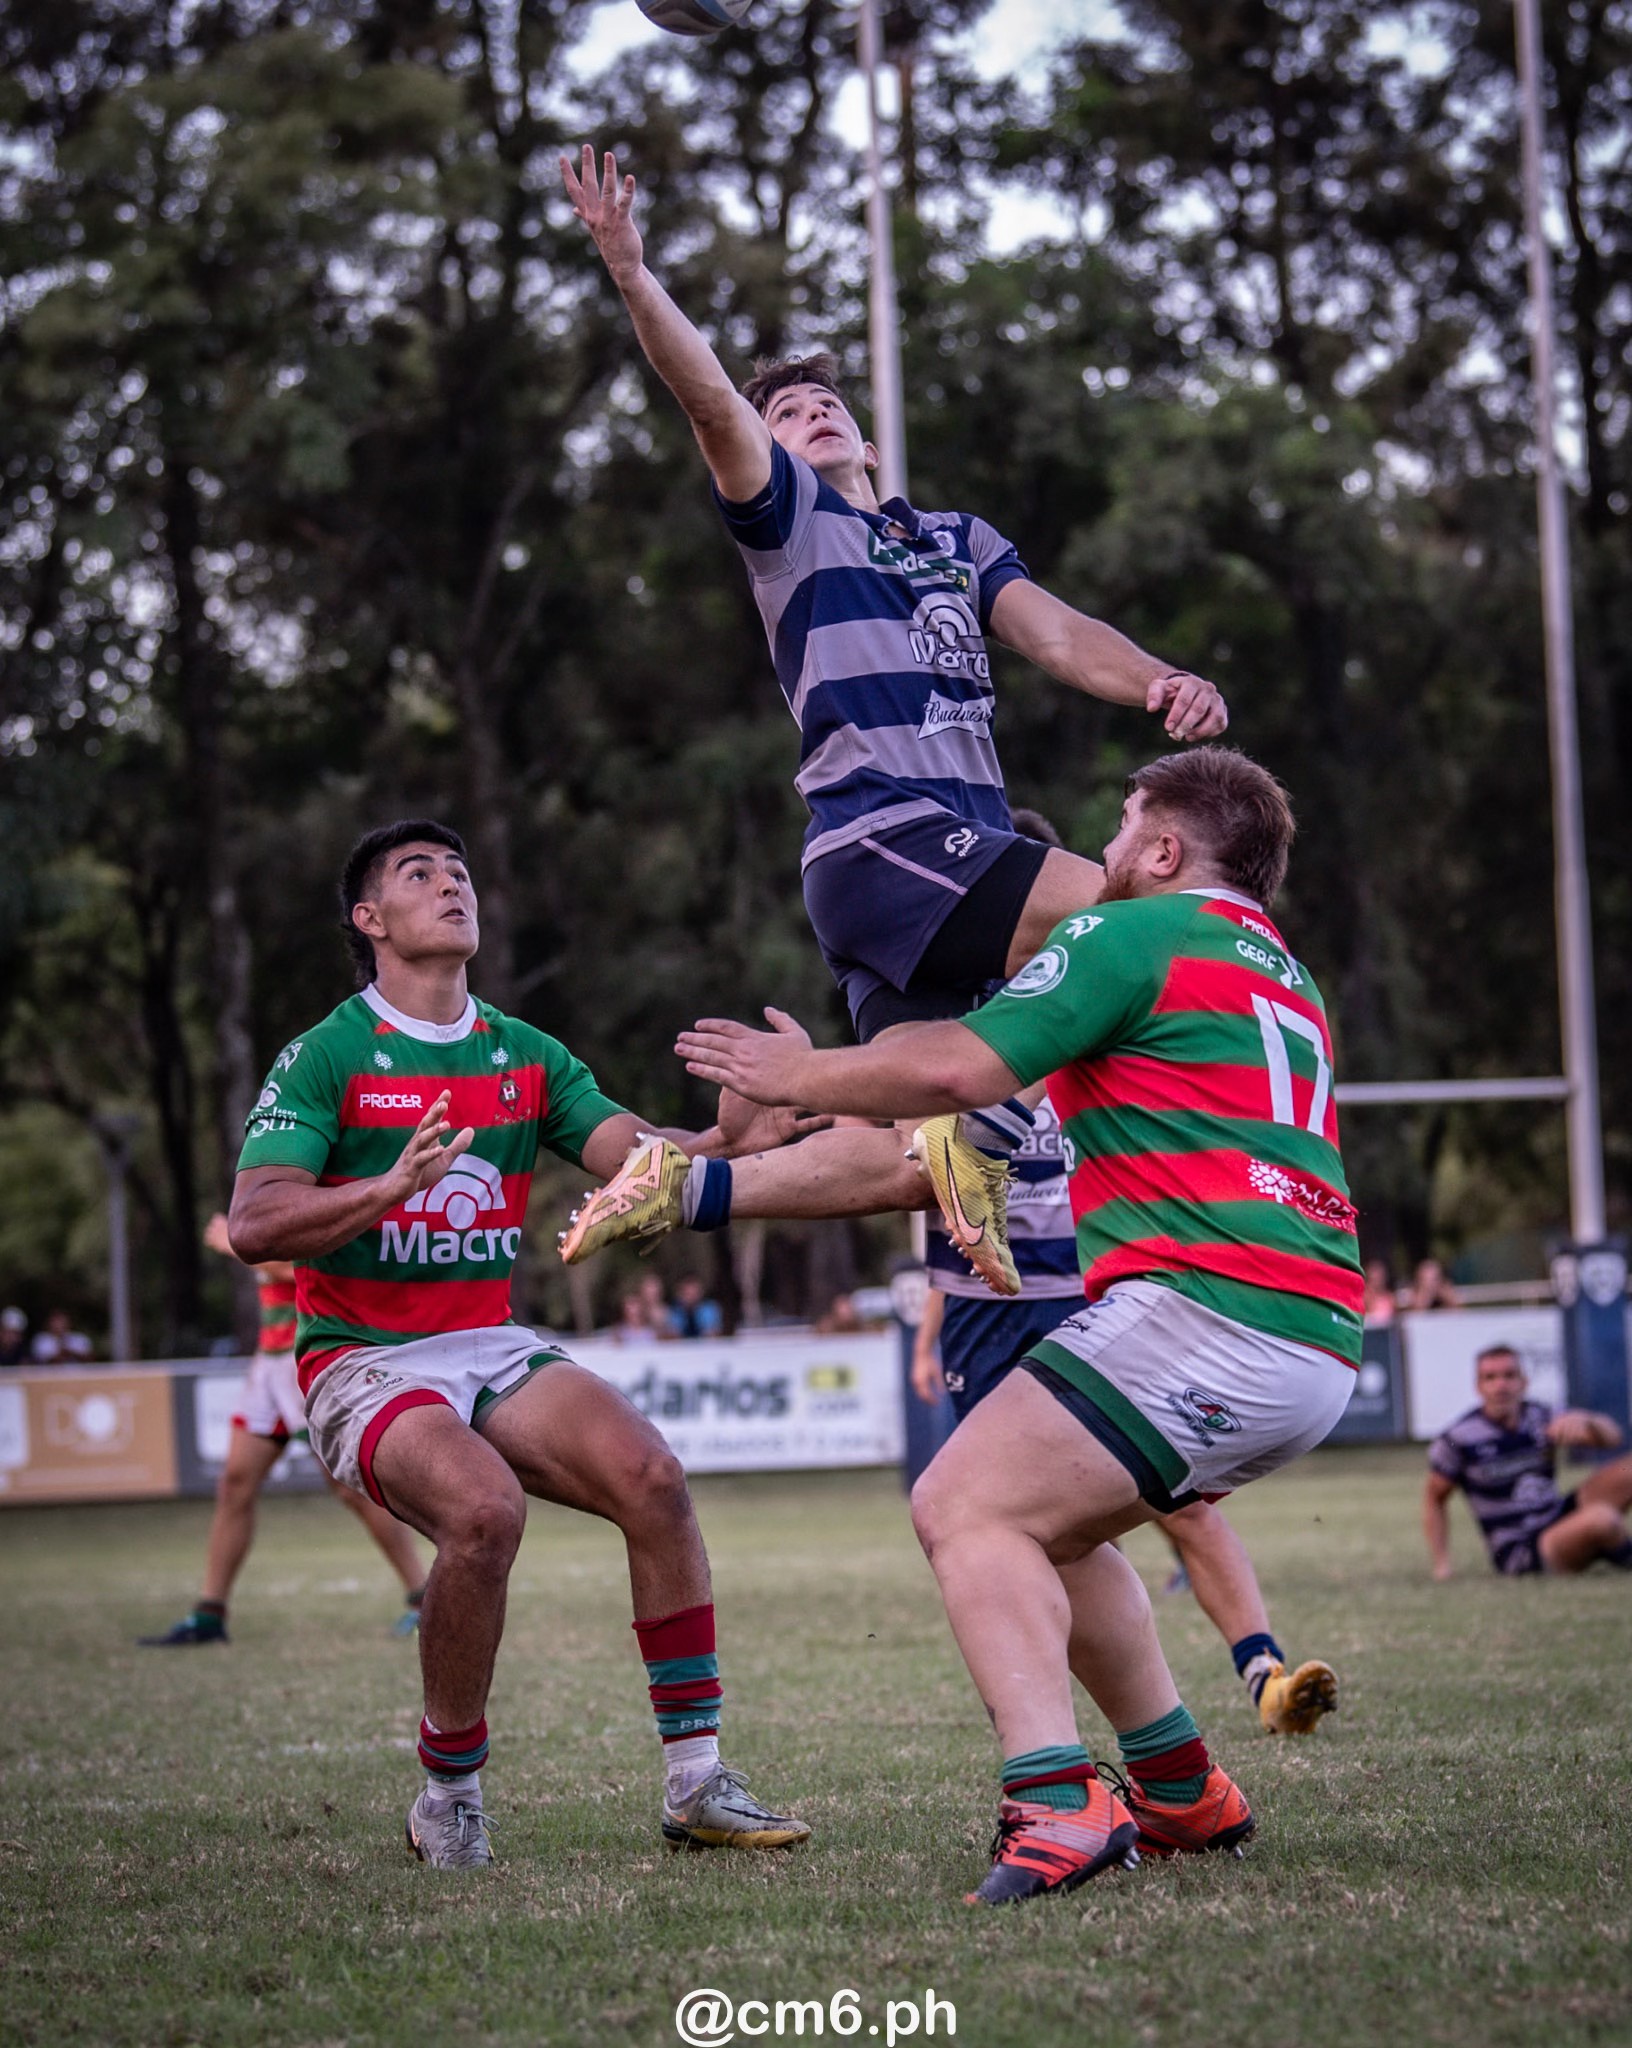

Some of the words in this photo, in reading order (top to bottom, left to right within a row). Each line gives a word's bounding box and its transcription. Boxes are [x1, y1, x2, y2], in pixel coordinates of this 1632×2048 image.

[1250, 991, 1330, 1138] 17
[359, 1093, 423, 1109] PROCER
[379, 1220, 522, 1265] Macro
